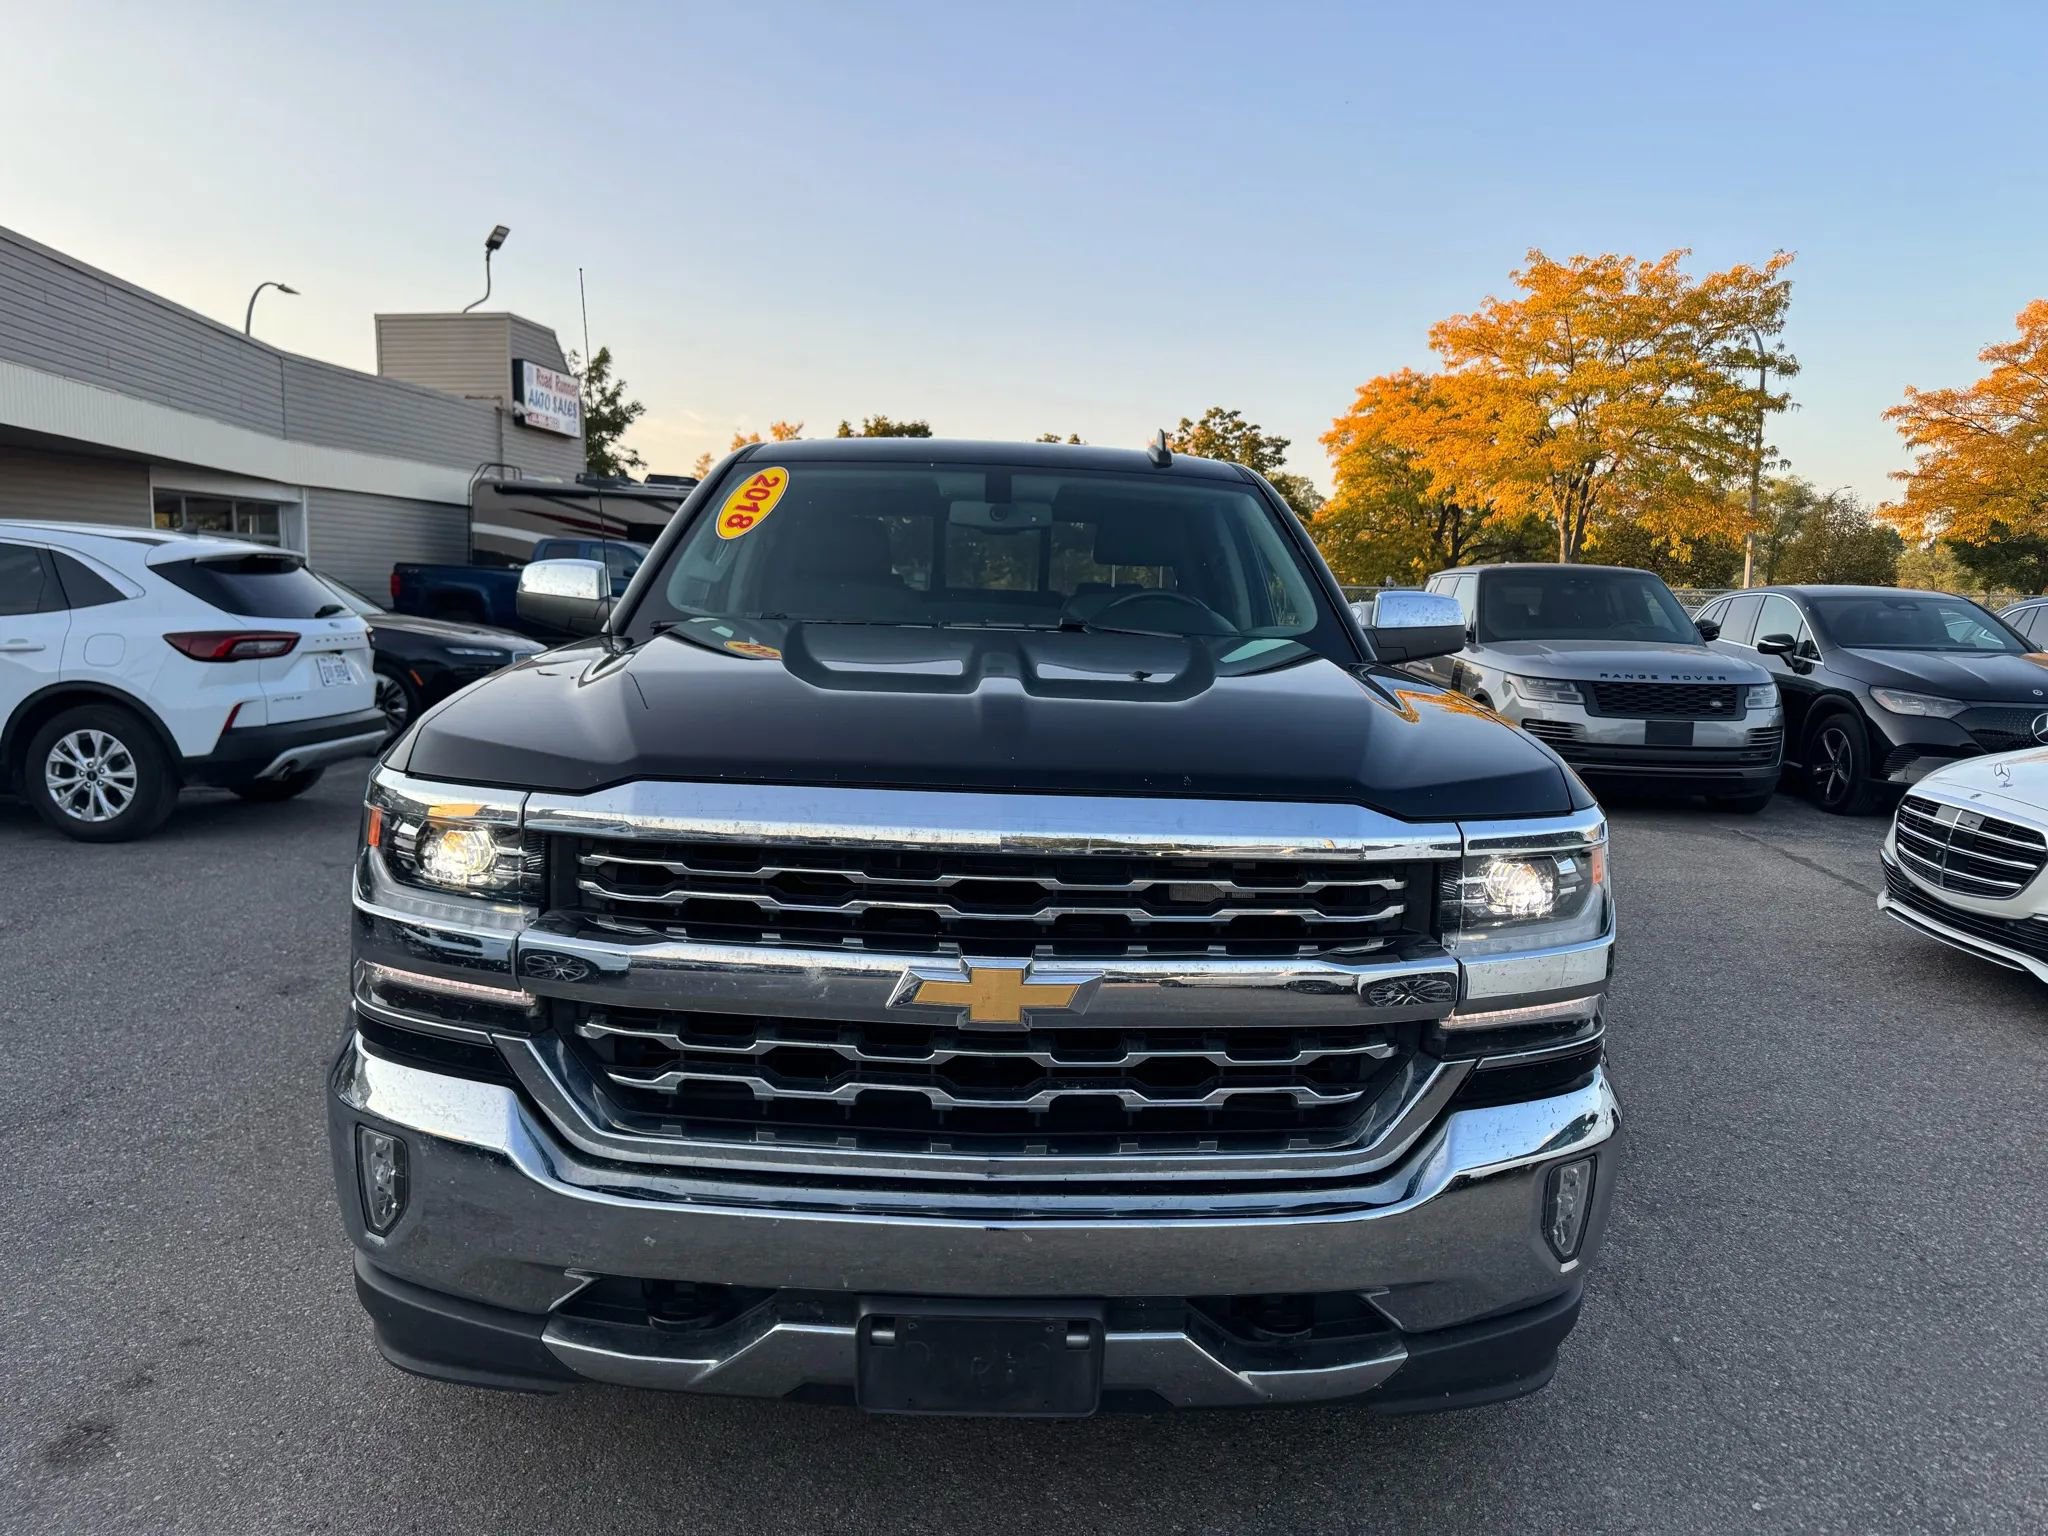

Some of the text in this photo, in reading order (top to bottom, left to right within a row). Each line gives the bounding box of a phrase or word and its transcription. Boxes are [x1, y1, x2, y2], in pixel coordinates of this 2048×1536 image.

[528, 388, 578, 419] AUTO SALES
[725, 474, 781, 529] 2018
[1599, 672, 1728, 682] RANGE ROVER
